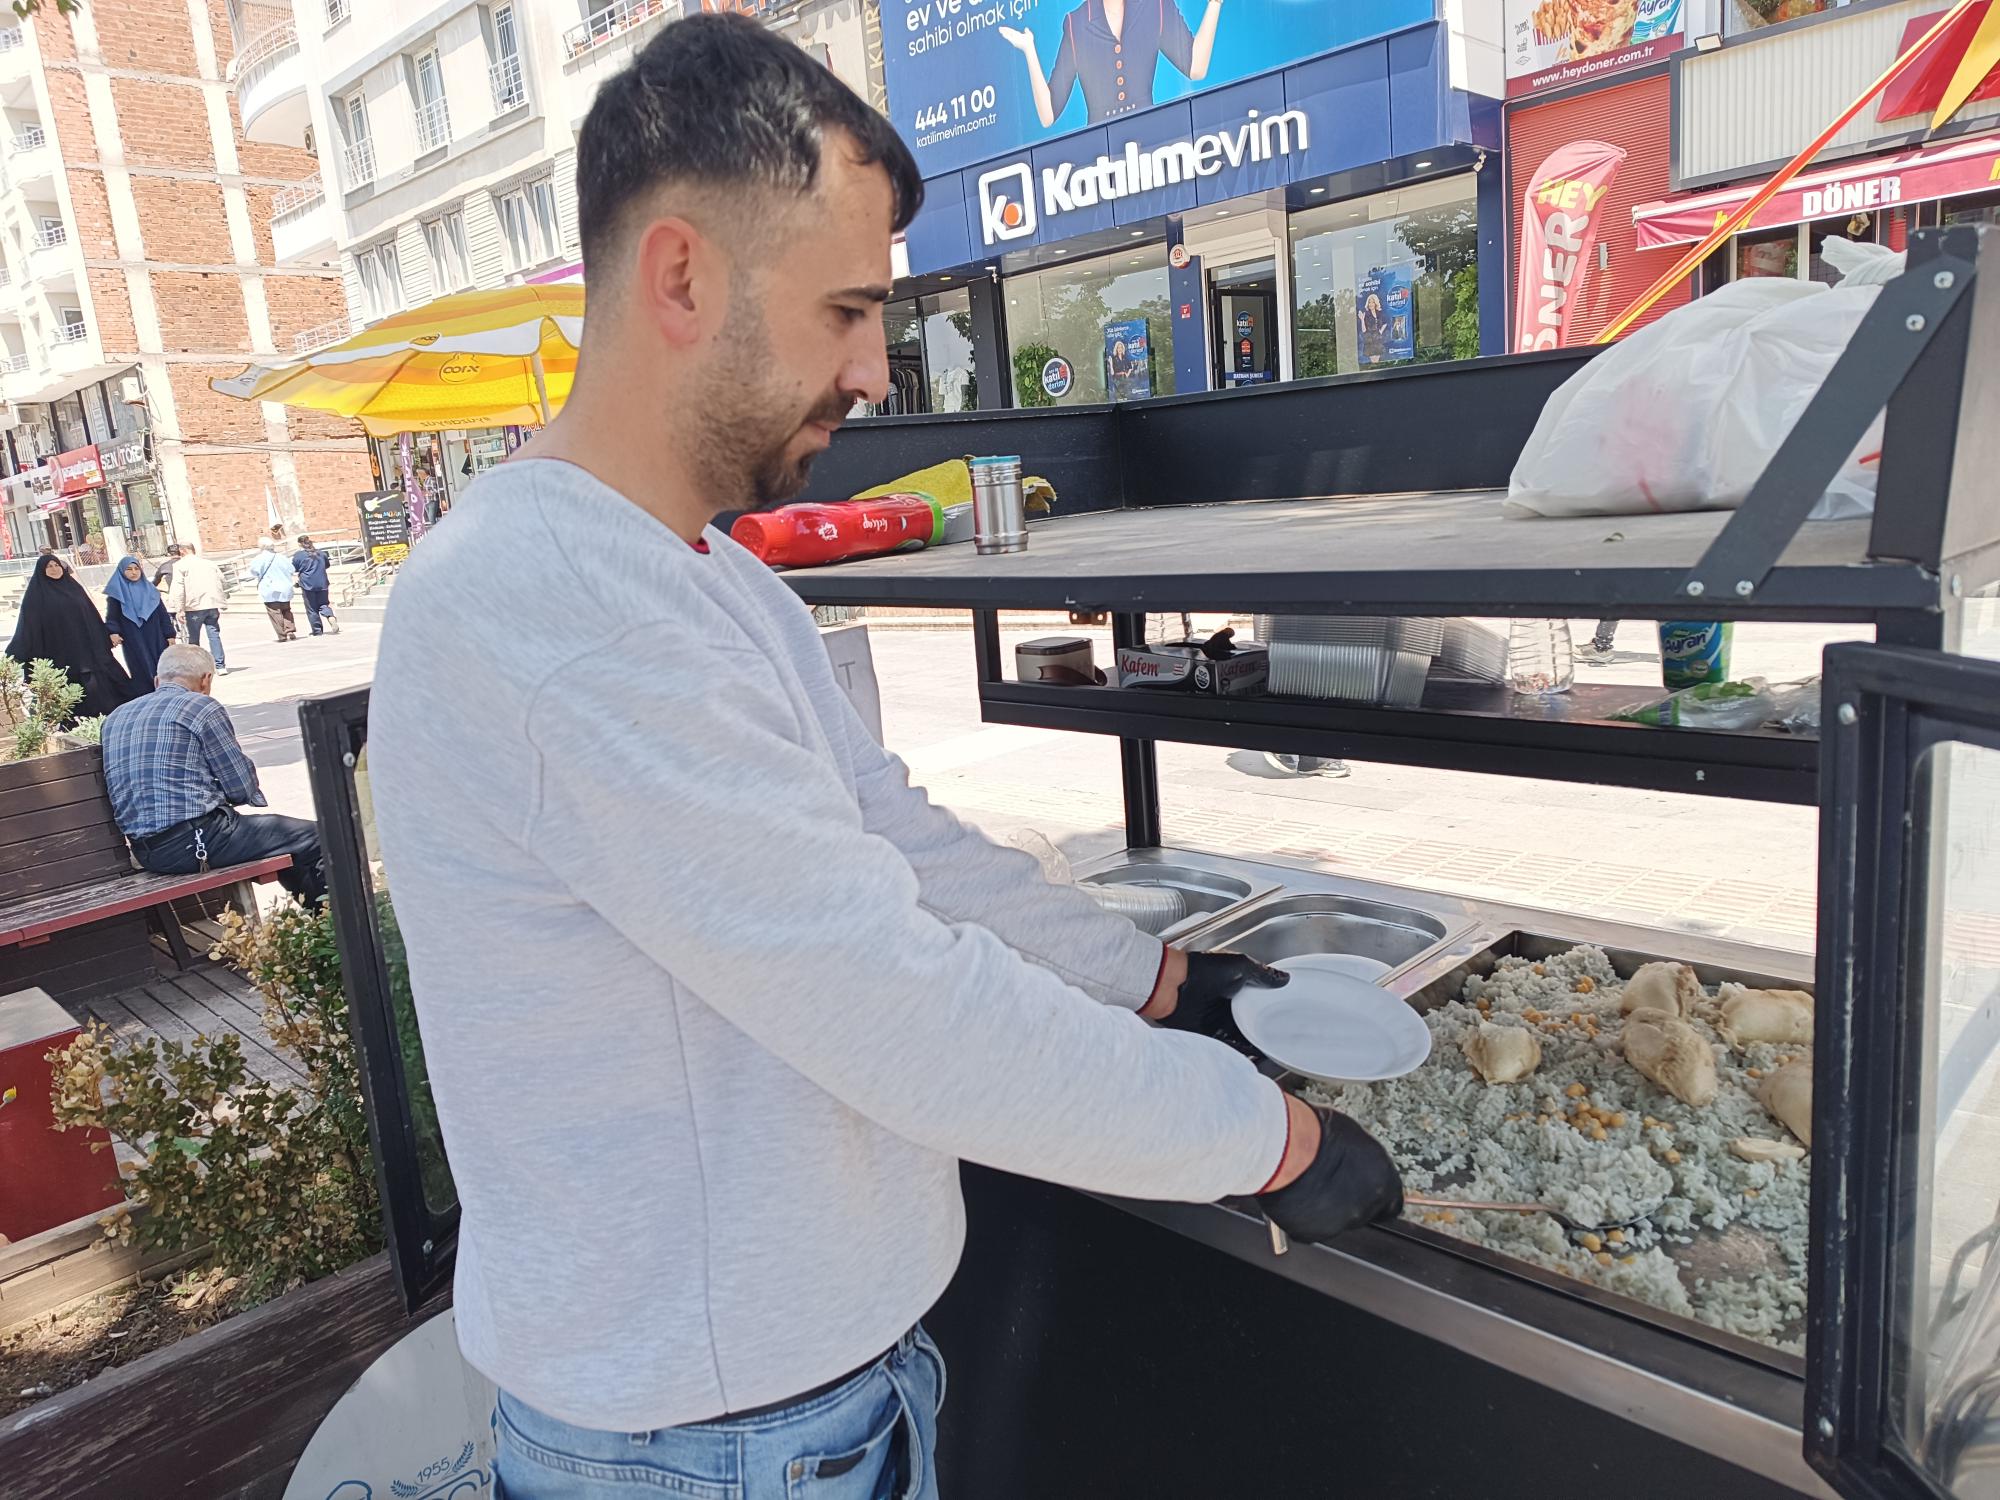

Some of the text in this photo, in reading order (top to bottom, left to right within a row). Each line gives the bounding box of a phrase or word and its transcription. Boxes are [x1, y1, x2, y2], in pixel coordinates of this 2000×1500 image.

[907, 0, 962, 31] ev ve
[908, 24, 952, 56] sahibi
[956, 1, 1005, 38] olmak
[1532, 46, 1655, 88] www.heydoner.com.tr
[915, 85, 996, 131] 444 11 00
[1537, 177, 1608, 212] HEY
[1802, 176, 1901, 217] DÖNER
[1665, 633, 1706, 653] Ayran
[1121, 655, 1159, 677] Kafem
[1220, 659, 1258, 676] Kafem
[417, 1457, 450, 1483] 1955
